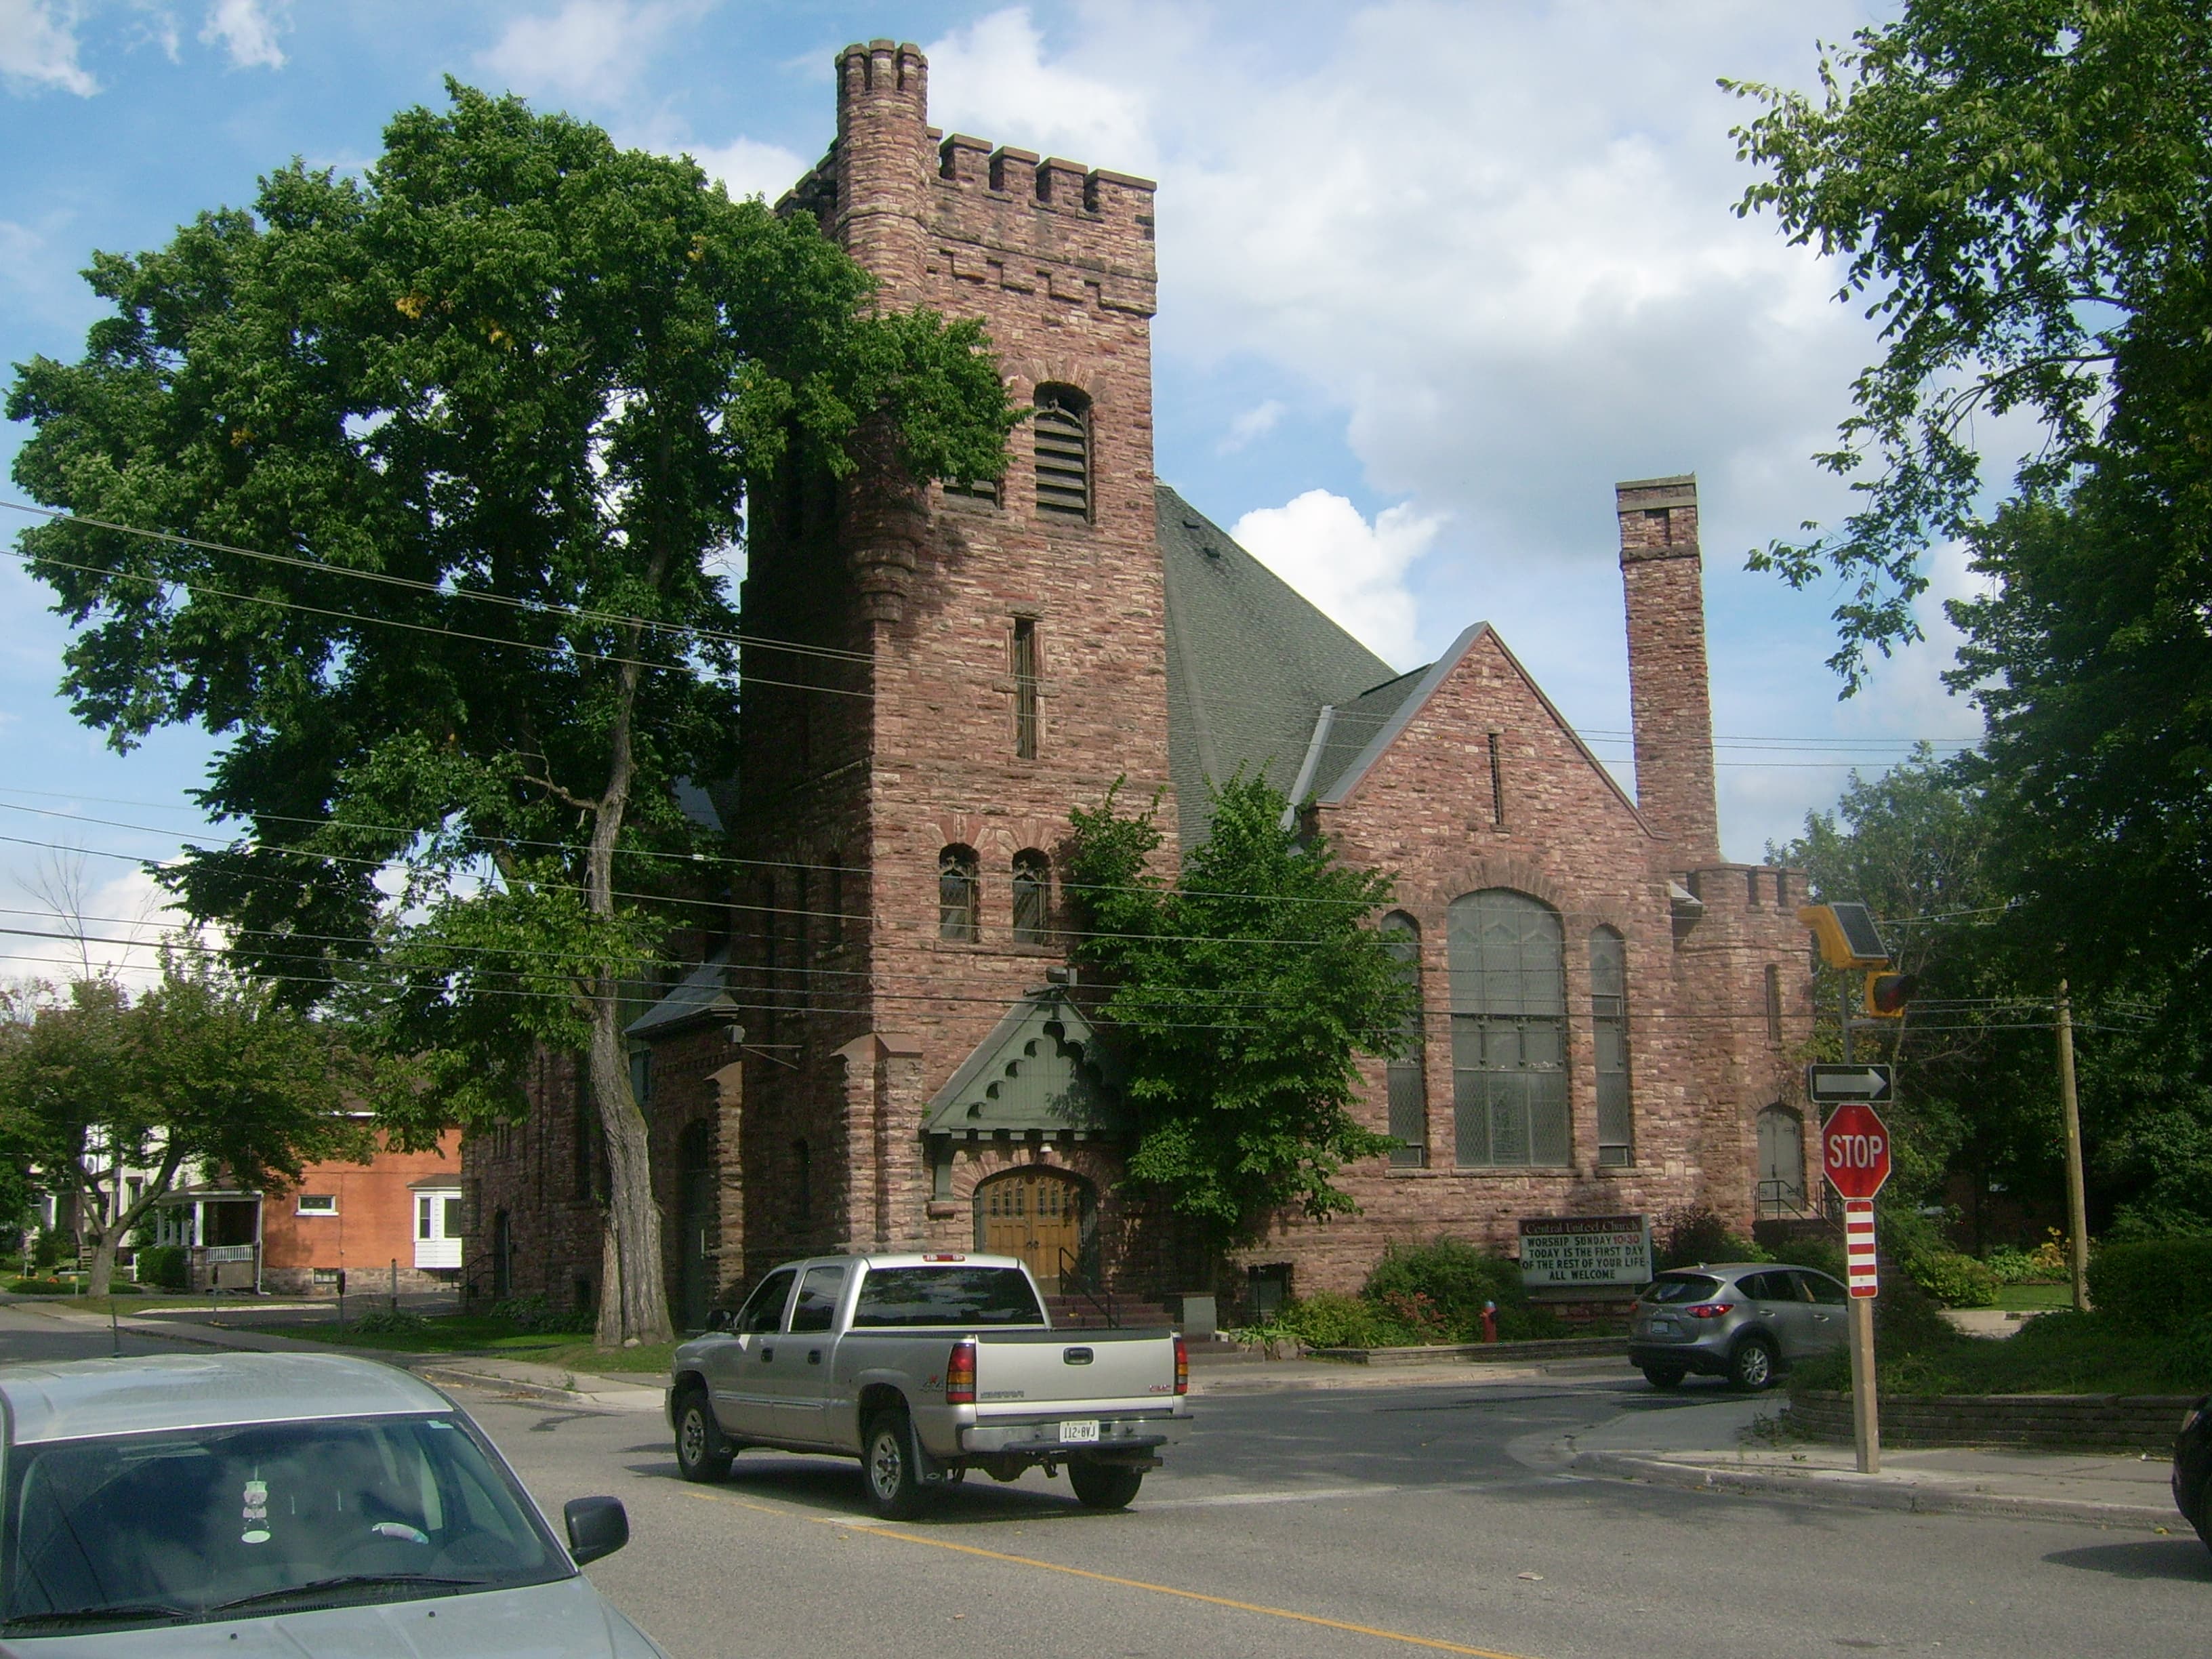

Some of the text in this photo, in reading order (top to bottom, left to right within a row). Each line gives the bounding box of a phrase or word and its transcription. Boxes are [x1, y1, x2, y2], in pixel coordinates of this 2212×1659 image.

[1830, 1135, 1883, 1168] STOP
[1525, 1220, 1638, 1234] Central United Church
[1528, 1236, 1569, 1248] WORSHIP
[1574, 1235, 1611, 1246] SUNDAY
[1529, 1246, 1644, 1258] TODAY IS THE FIRST DAY
[1522, 1261, 1534, 1269] OF
[1536, 1260, 1553, 1269] THE
[1557, 1259, 1580, 1269] REST
[1582, 1258, 1593, 1268] OF
[1597, 1258, 1622, 1268] YOUR
[1549, 1269, 1616, 1280] ALL WELCOME
